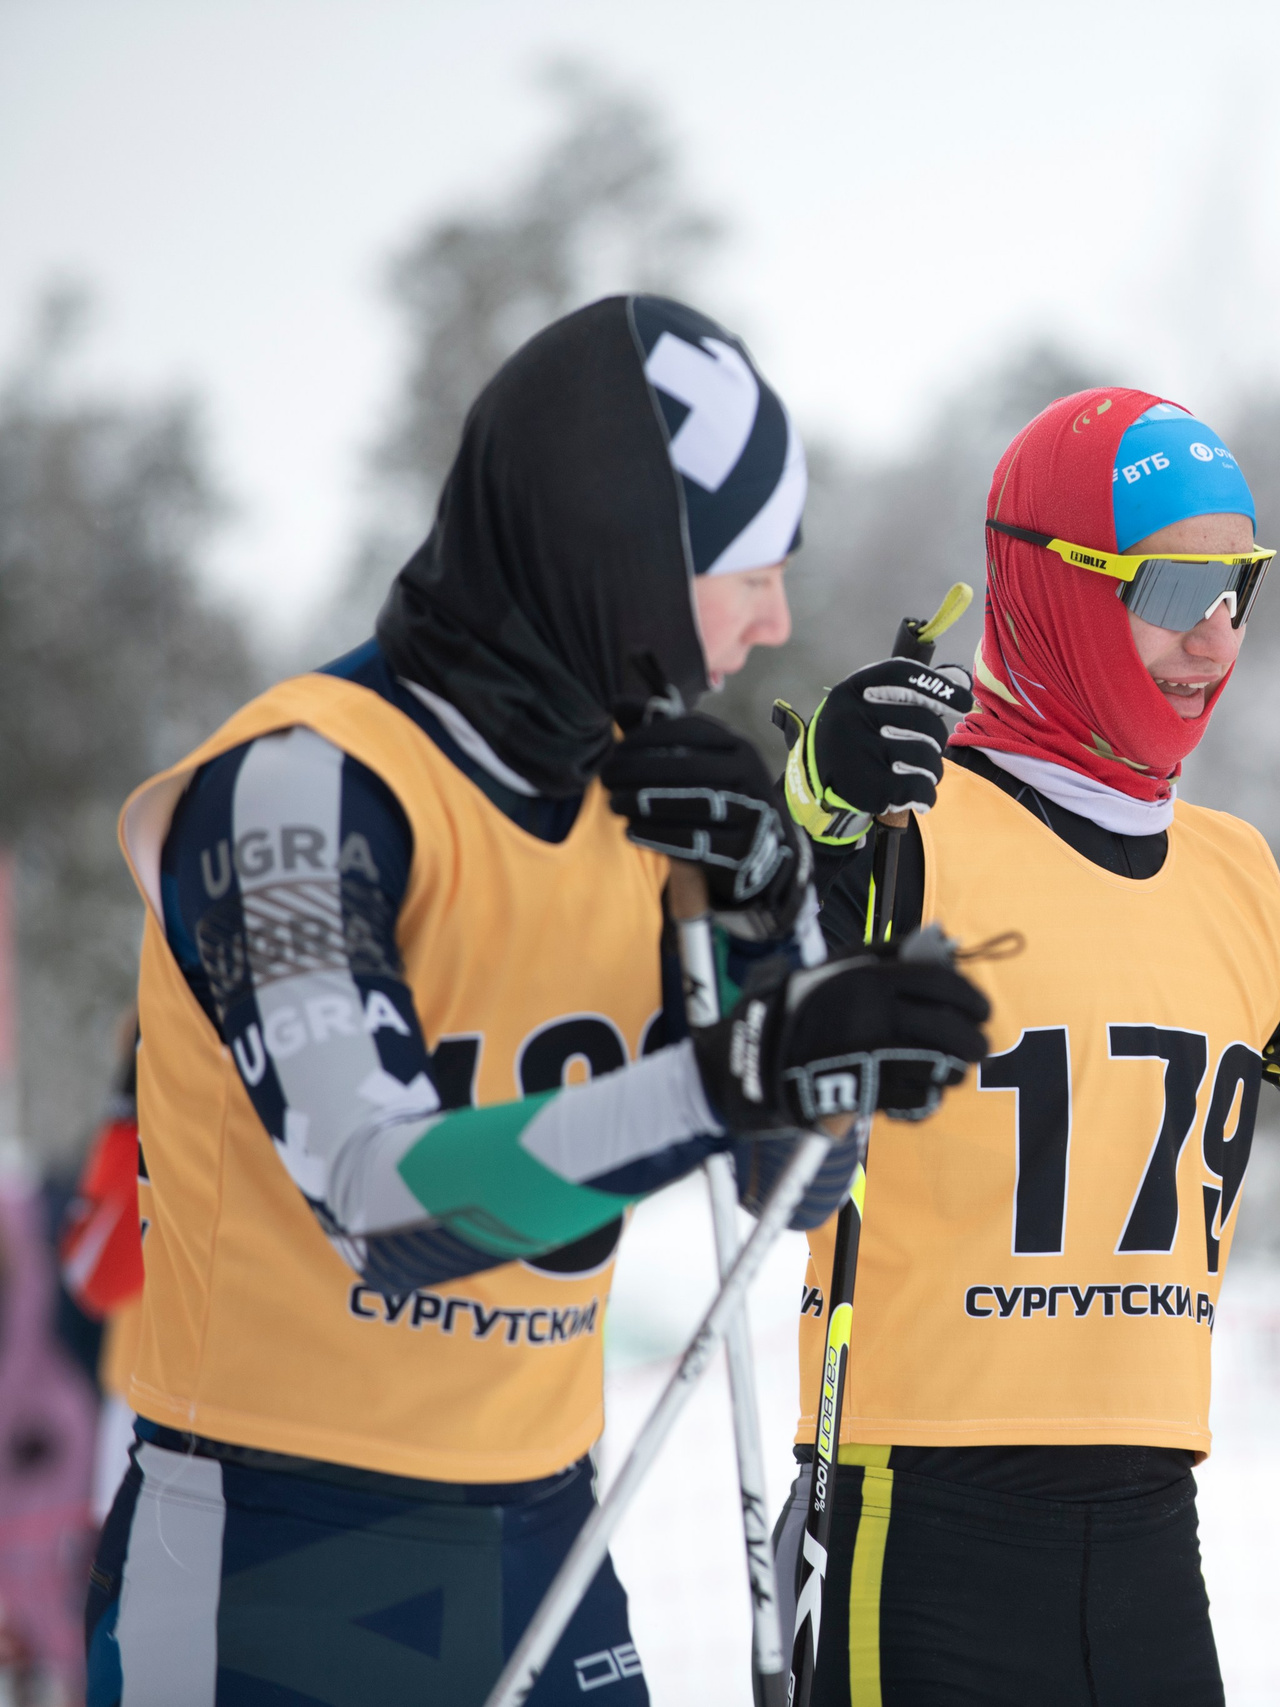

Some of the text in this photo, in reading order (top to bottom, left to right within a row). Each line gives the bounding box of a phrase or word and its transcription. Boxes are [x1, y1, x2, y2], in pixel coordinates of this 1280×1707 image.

[1121, 451, 1170, 485] ВТБ
[201, 824, 381, 899] UGRA
[233, 989, 412, 1087] UGRA
[976, 1023, 1243, 1277] 179
[964, 1281, 1195, 1319] СУРГУТСКИ
[813, 1458, 829, 1513] 100%
